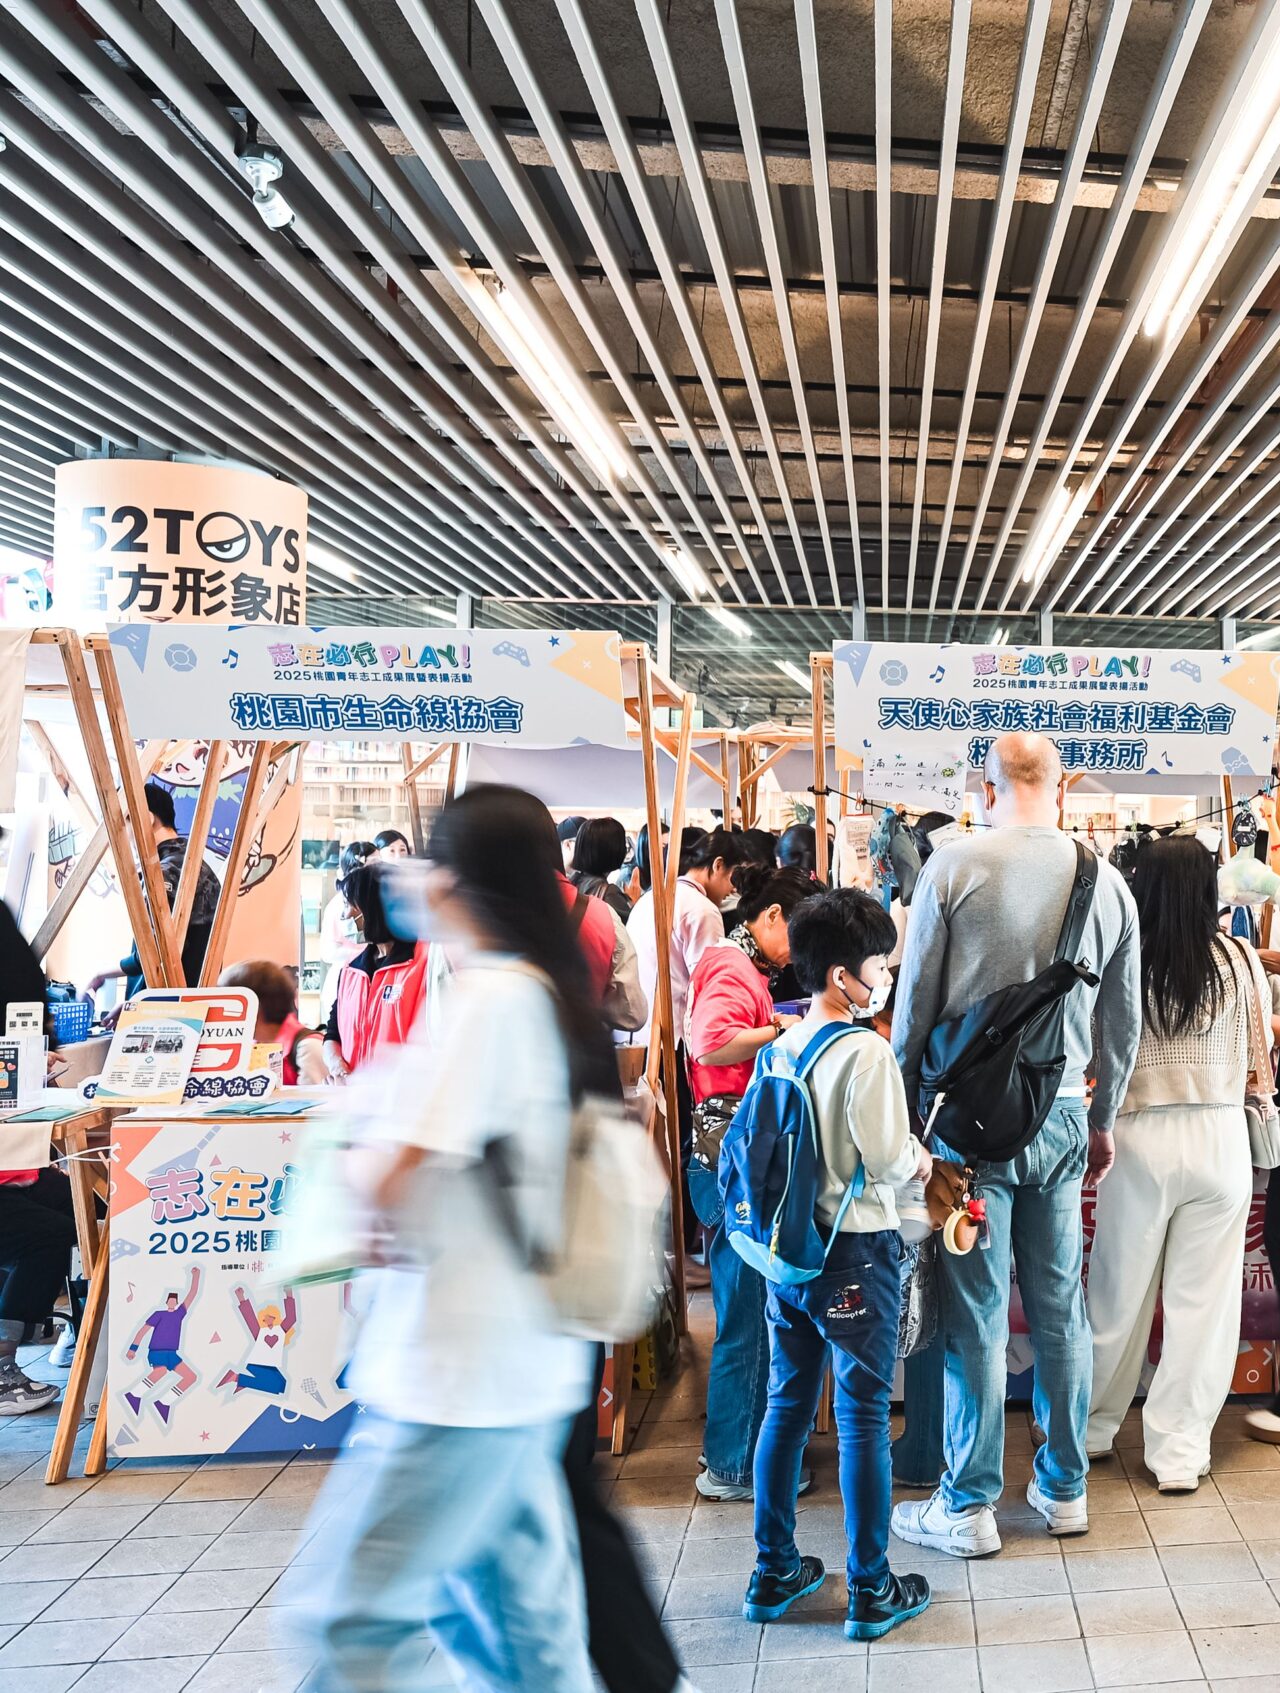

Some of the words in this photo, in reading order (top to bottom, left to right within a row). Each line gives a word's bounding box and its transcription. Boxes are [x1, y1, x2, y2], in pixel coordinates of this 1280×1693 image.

[267, 641, 378, 667] 志在必行
[380, 644, 472, 669] PLAY!
[972, 652, 1069, 676] 志在必行
[1071, 655, 1152, 678] PLAY!
[230, 693, 524, 733] 桃園市生命線協會
[878, 698, 1235, 735] 天使心家族社會福利基金會
[968, 737, 1148, 770] 桃事務所
[826, 1307, 867, 1320] helicopter
